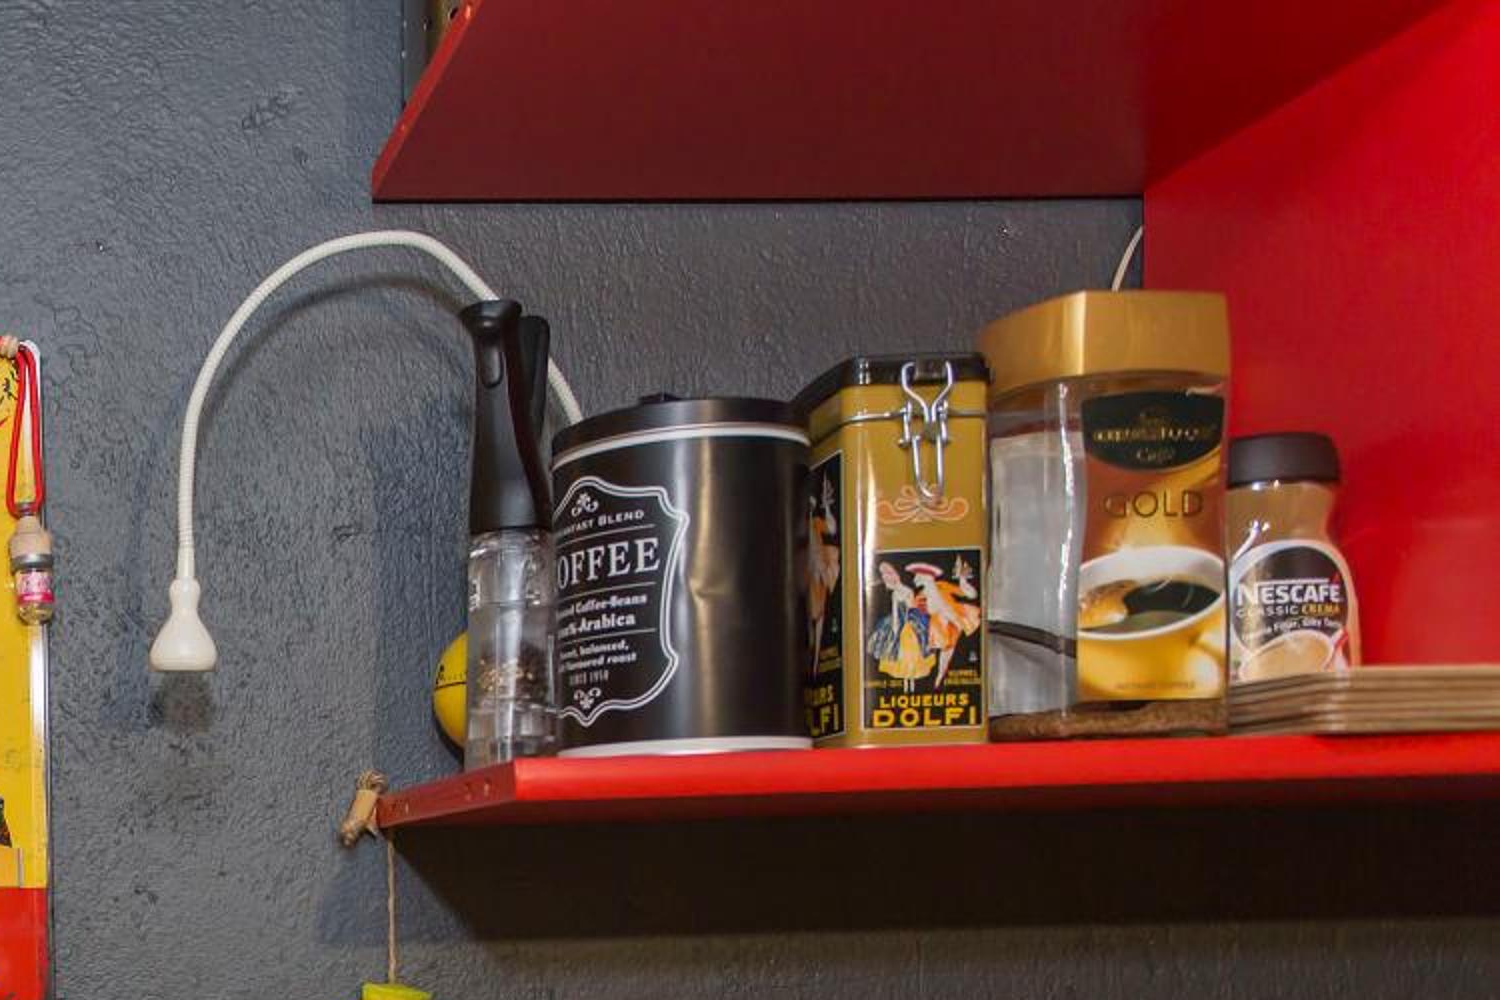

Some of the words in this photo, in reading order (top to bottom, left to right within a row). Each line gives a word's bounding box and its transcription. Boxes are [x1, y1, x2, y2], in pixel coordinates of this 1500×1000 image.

[1104, 489, 1204, 519] GOLD
[597, 508, 645, 527] BLEND
[557, 537, 661, 590] OFFEE
[879, 692, 970, 709] LIQUEURS
[872, 705, 978, 728] DOLFI
